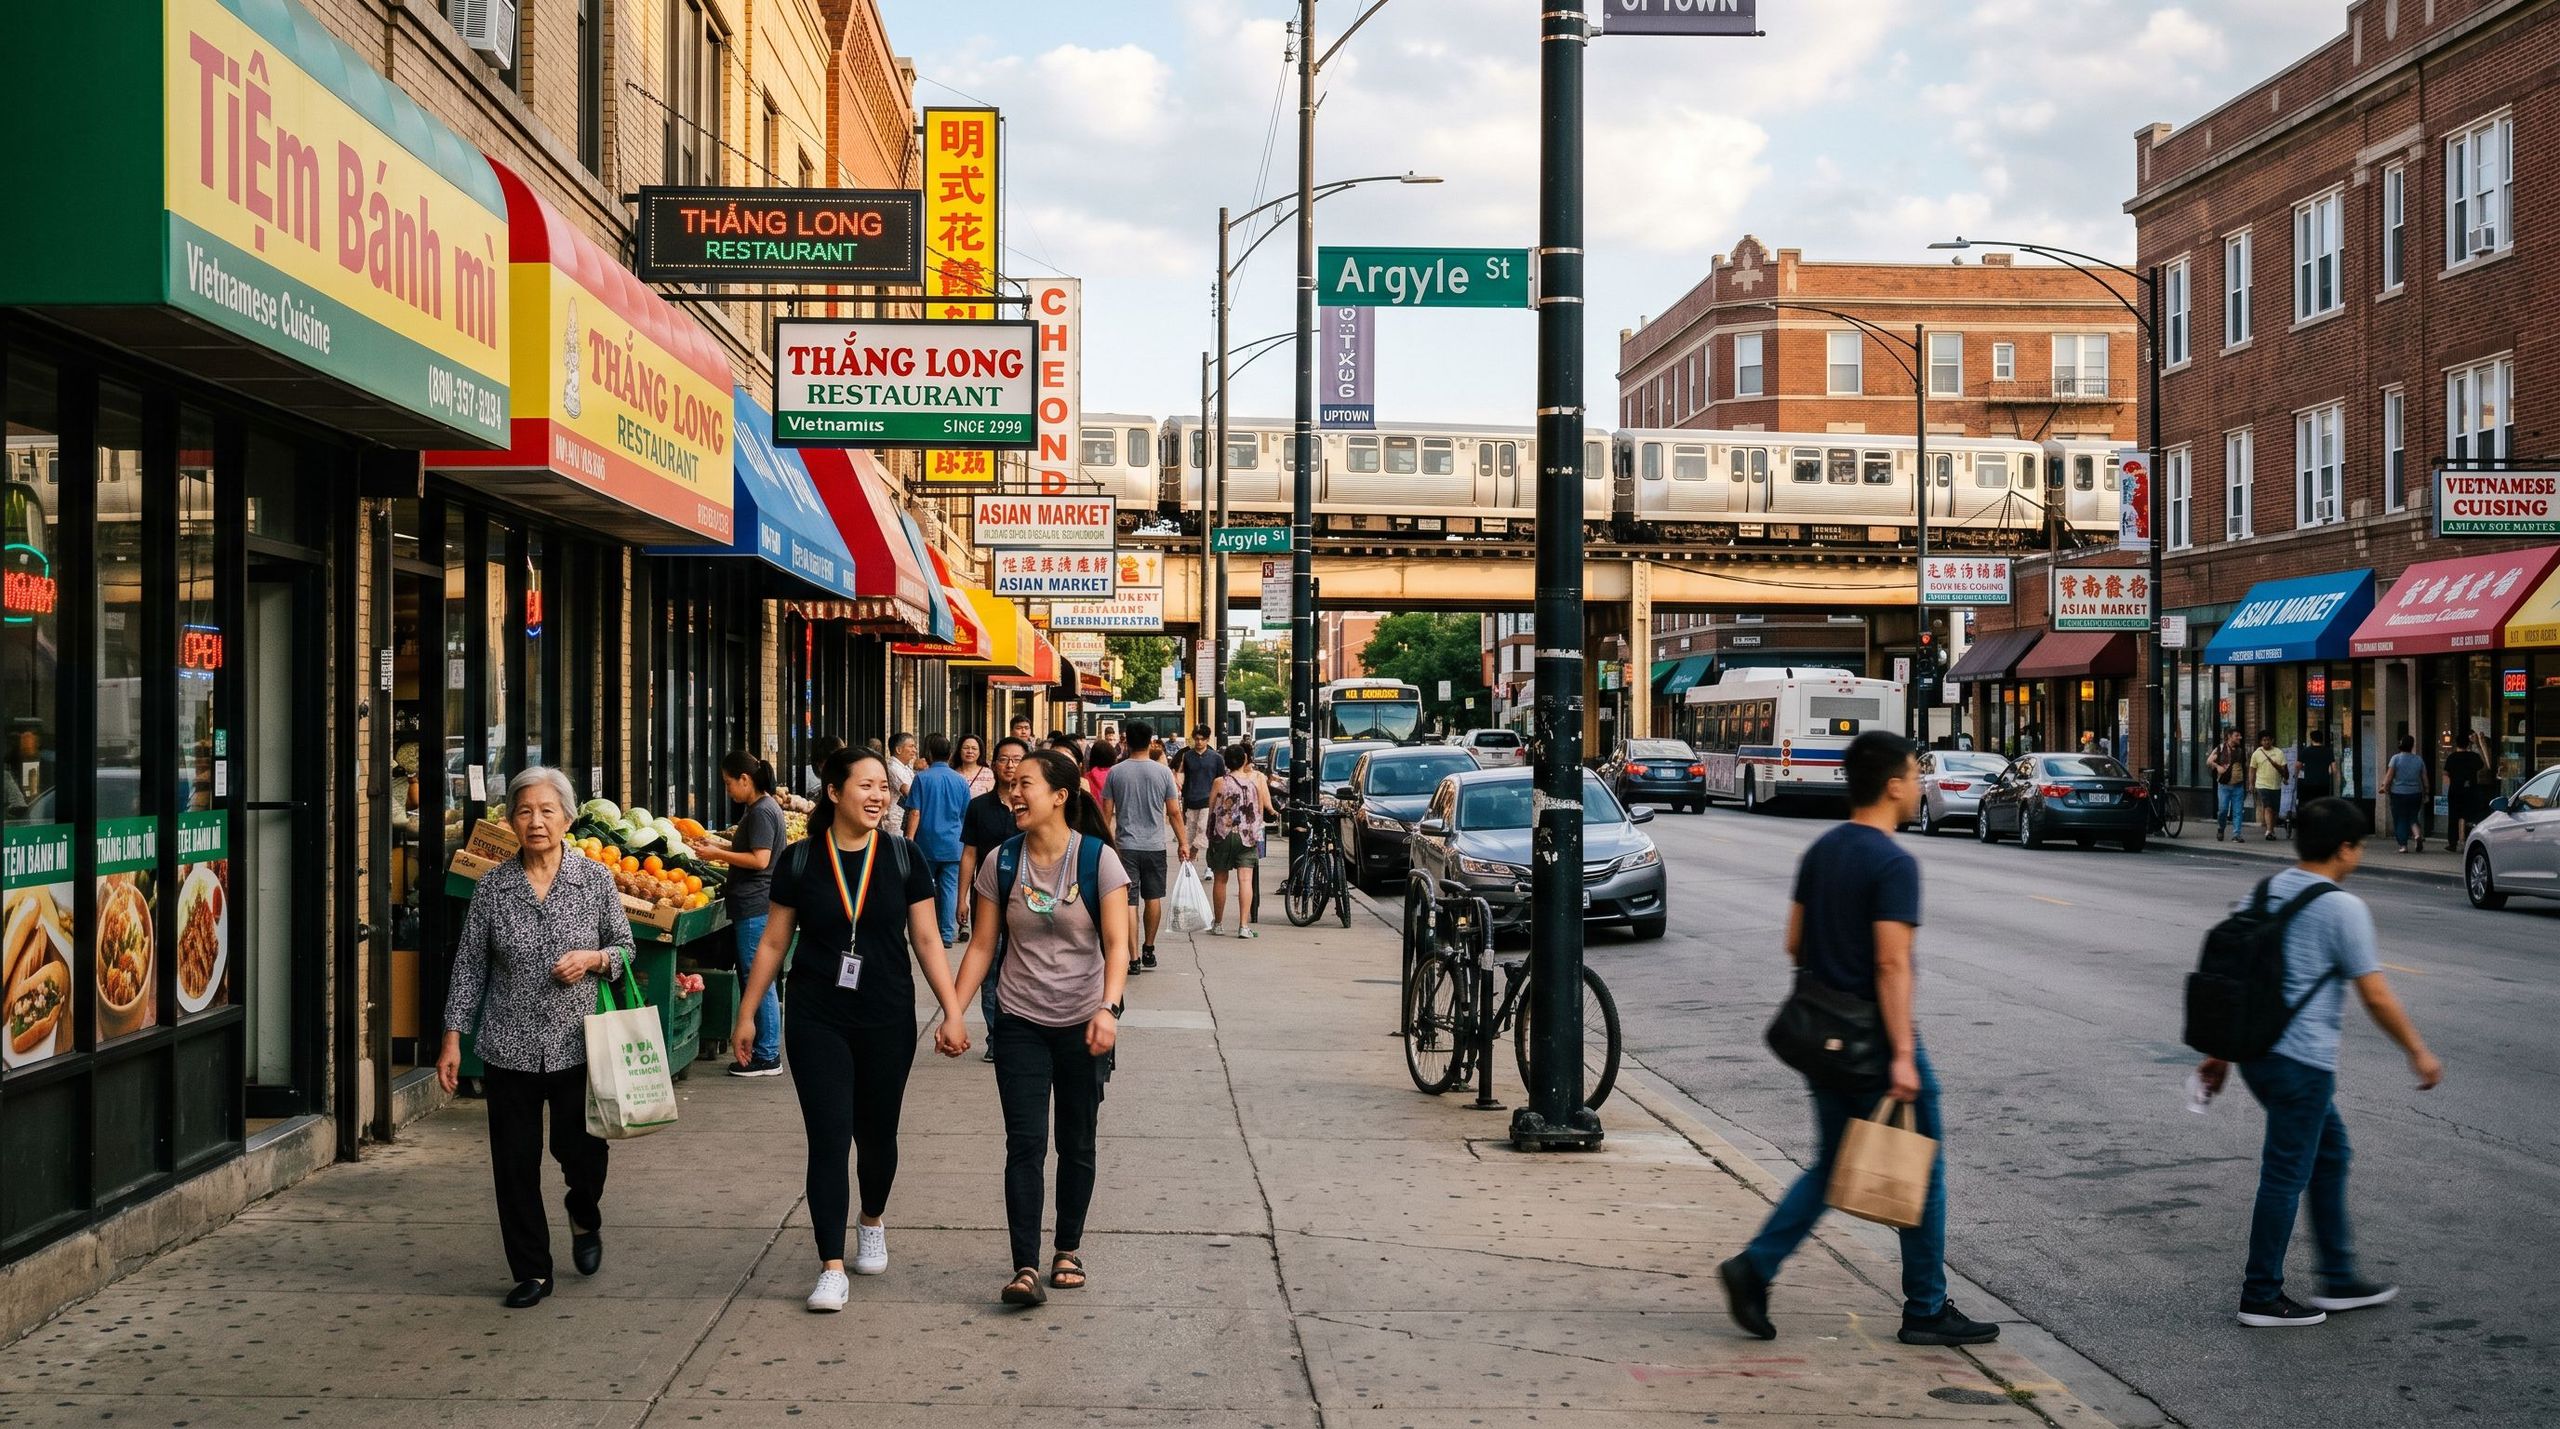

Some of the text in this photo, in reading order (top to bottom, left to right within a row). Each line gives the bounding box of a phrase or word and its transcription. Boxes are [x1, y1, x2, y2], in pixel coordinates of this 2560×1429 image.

[798, 212, 882, 236] LONG
[338, 139, 442, 321] Bánh
[455, 232, 496, 350] mì
[706, 240, 858, 262] RESTAURANT
[1336, 256, 1511, 305] Argyle St
[187, 241, 331, 355] Vietnamese Cuisine
[787, 331, 1024, 379] THẮNG LONG
[807, 383, 1004, 408] RESTAURANT
[673, 384, 724, 456] LONG
[943, 419, 985, 434] SINCE
[989, 420, 1023, 435] 2999
[1323, 409, 1369, 422] UPTOWN
[618, 413, 699, 484] RESTAURANT
[2445, 477, 2557, 495] VIETNAMESE
[979, 503, 1111, 526] ASIAN MARKET
[2453, 499, 2549, 516] CUISING
[1217, 532, 1268, 550] Argyle
[999, 577, 1109, 592] ASIAN MARKET
[2061, 603, 2148, 616] ASIAN MARKET
[2229, 599, 2285, 630] ASIAN
[2270, 591, 2347, 626] MARKET
